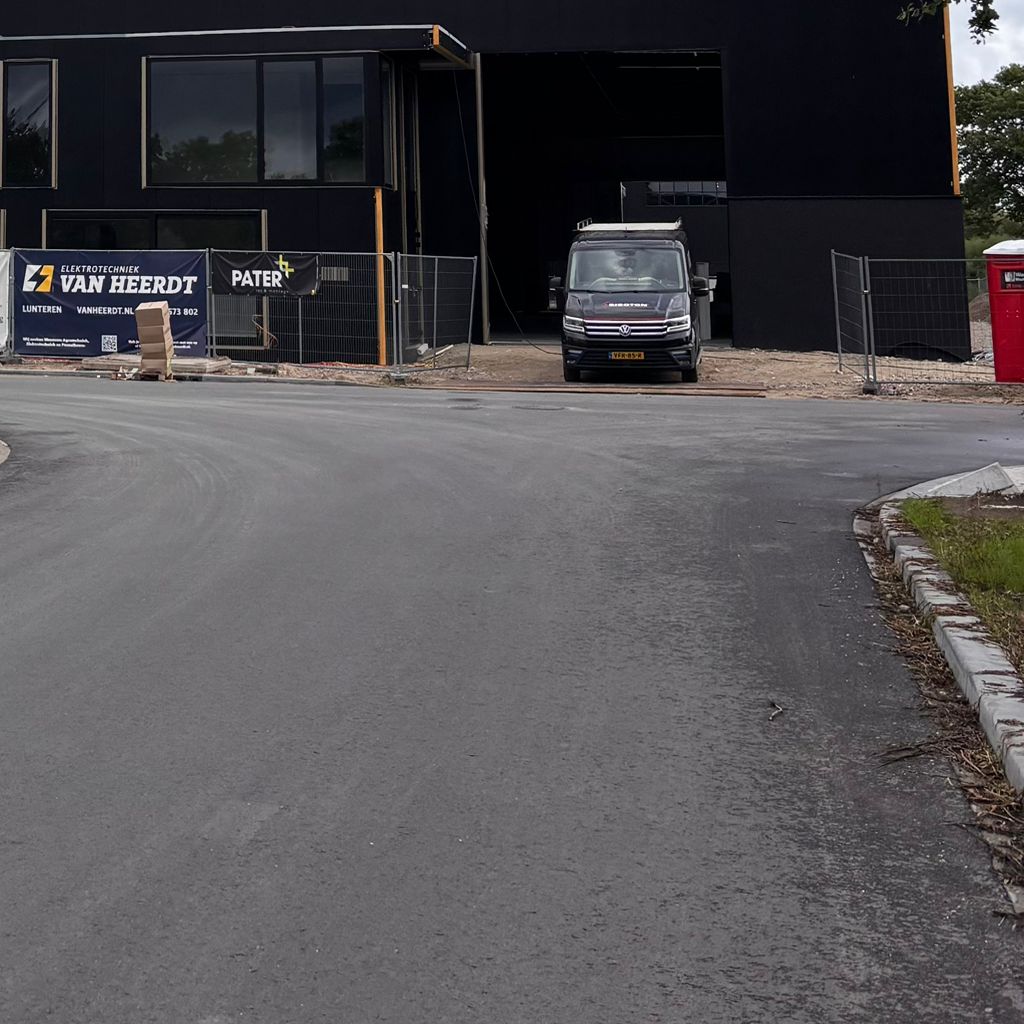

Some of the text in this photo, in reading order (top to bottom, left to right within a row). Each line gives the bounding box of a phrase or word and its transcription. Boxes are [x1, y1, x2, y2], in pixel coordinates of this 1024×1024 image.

[60, 265, 140, 274] ELEKTROTECHNIEK
[231, 269, 283, 288] PATER
[60, 275, 198, 295] VAN HEERDT
[22, 305, 63, 314] LUNTEREN
[76, 305, 135, 315] VANHEERDT.NL
[183, 308, 199, 316] 802
